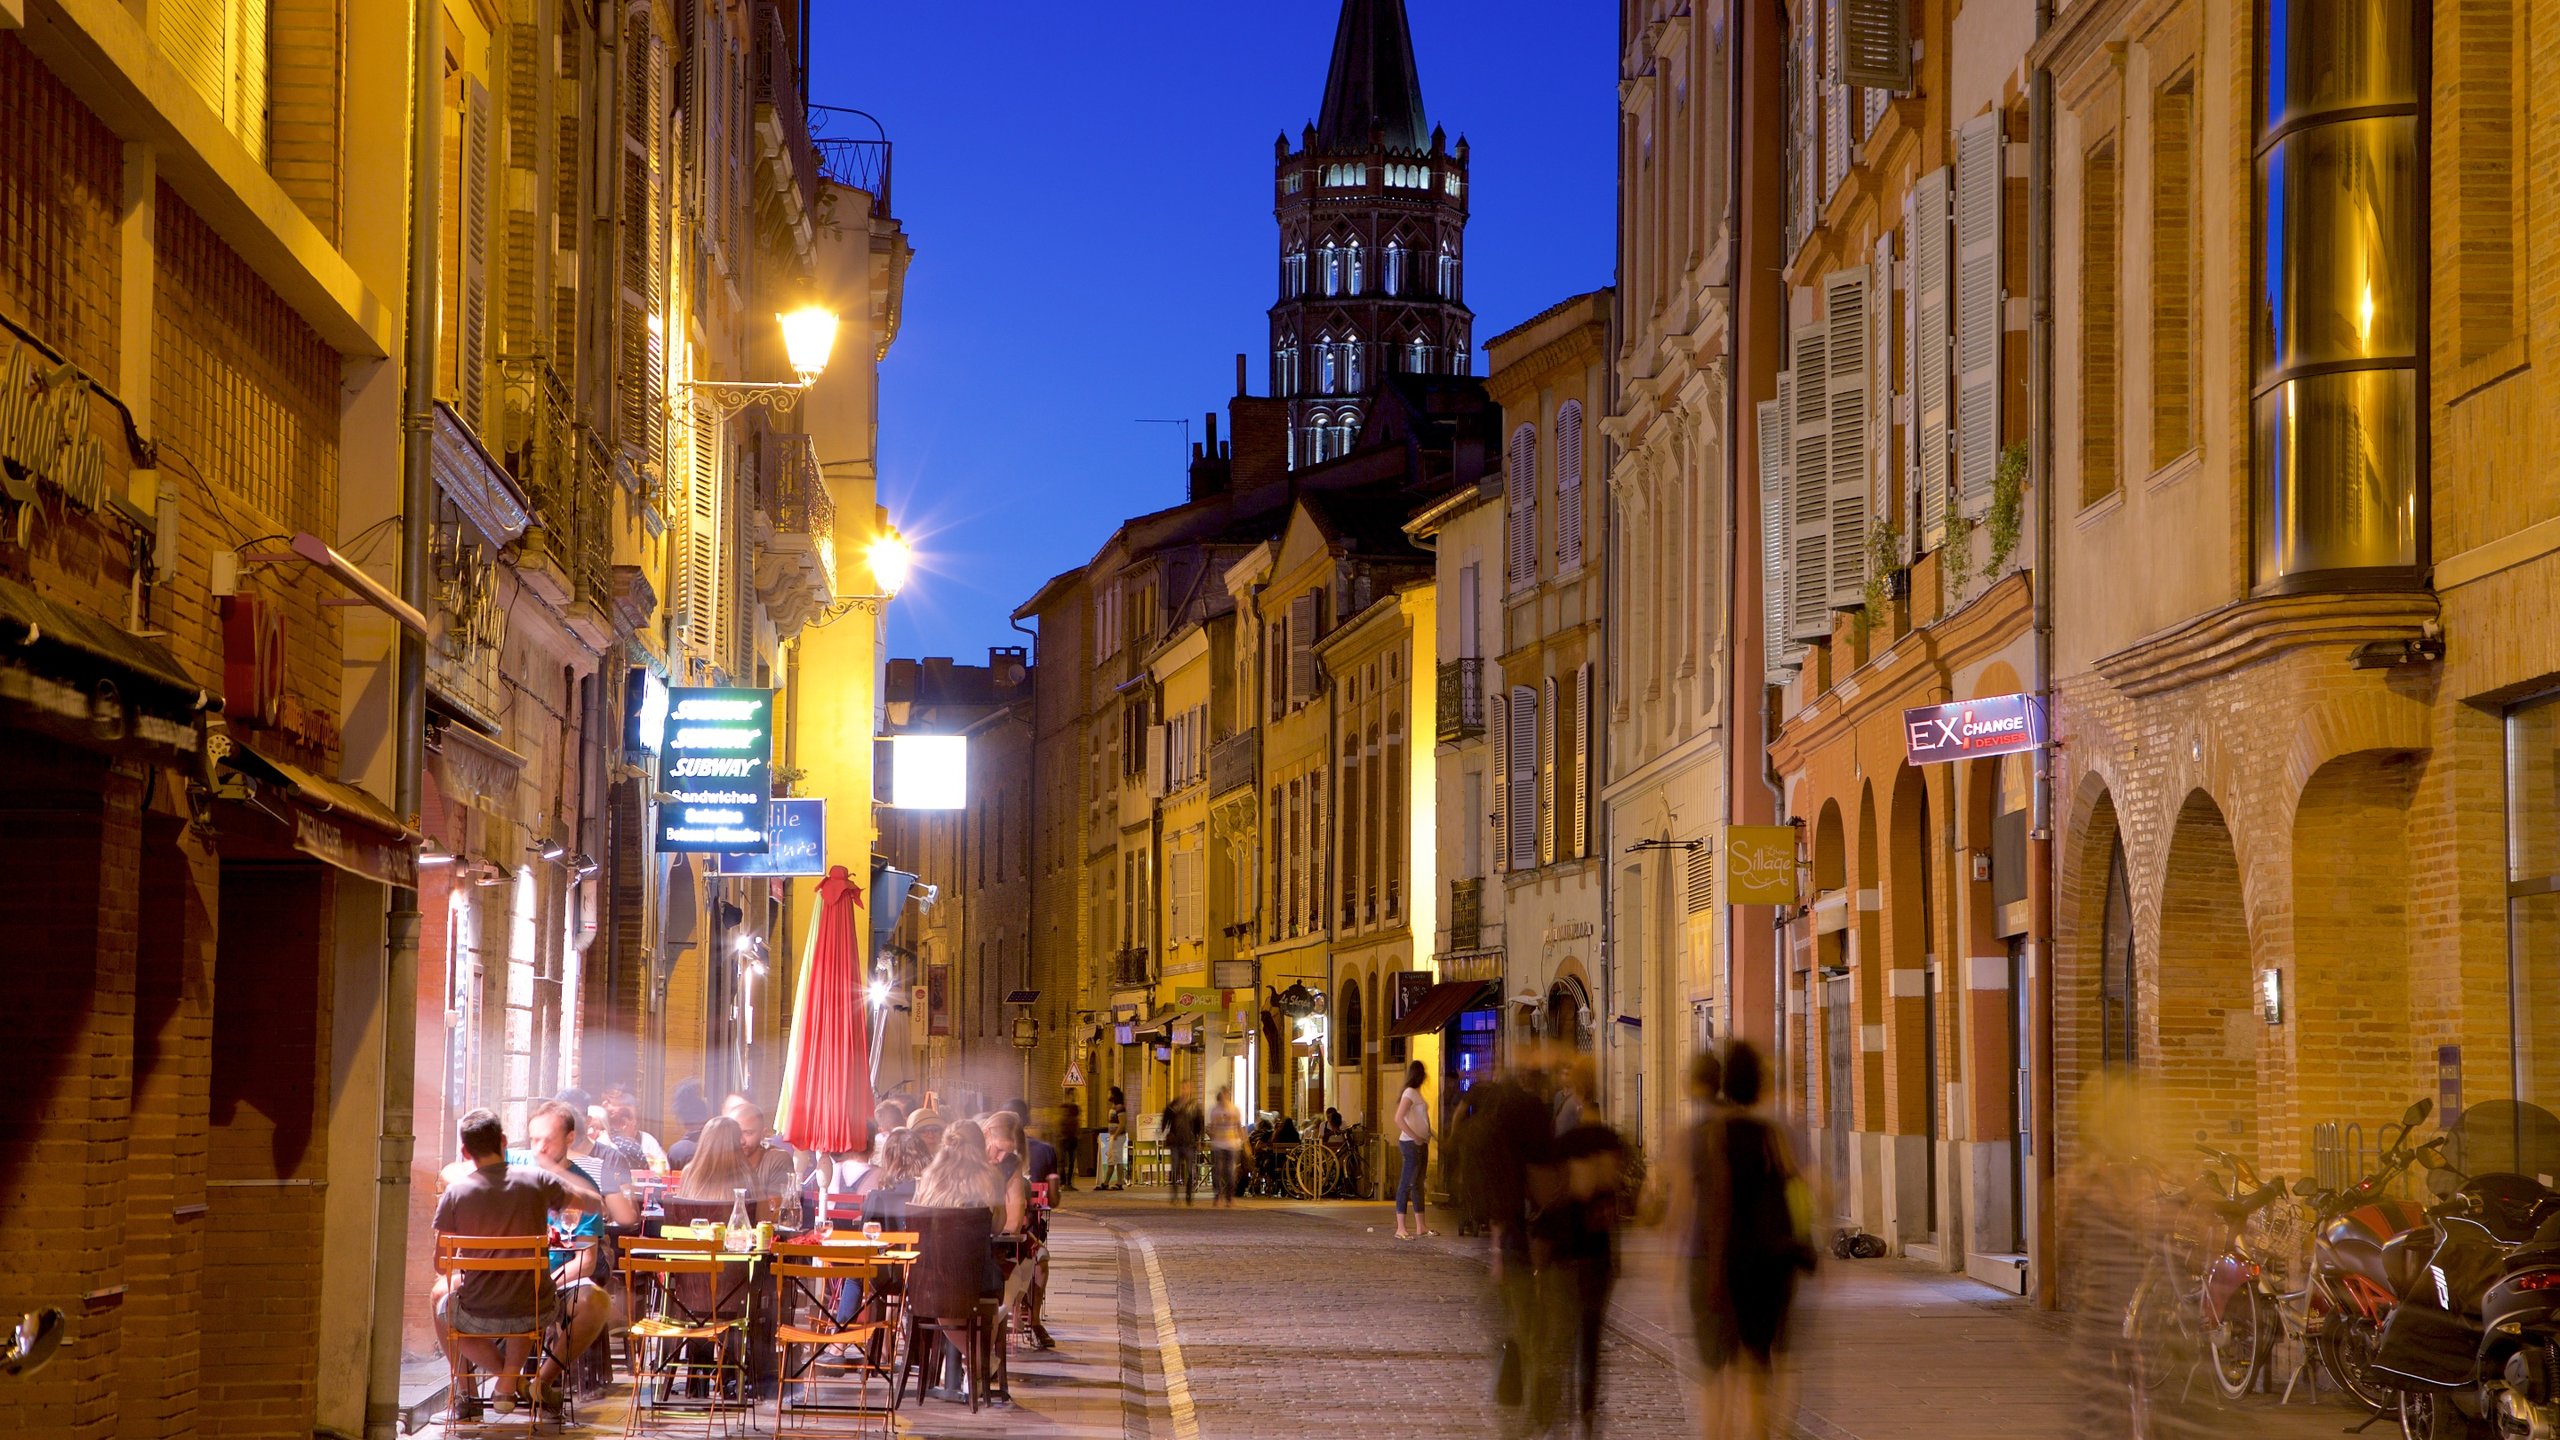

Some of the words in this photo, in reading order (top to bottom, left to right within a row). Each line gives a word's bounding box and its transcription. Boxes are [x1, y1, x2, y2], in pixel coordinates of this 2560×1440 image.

[1975, 732, 2028, 748] DEVISES
[670, 757, 760, 777] SUBWAY
[672, 789, 758, 804] Sandwiches
[1731, 840, 1791, 885] Sillage
